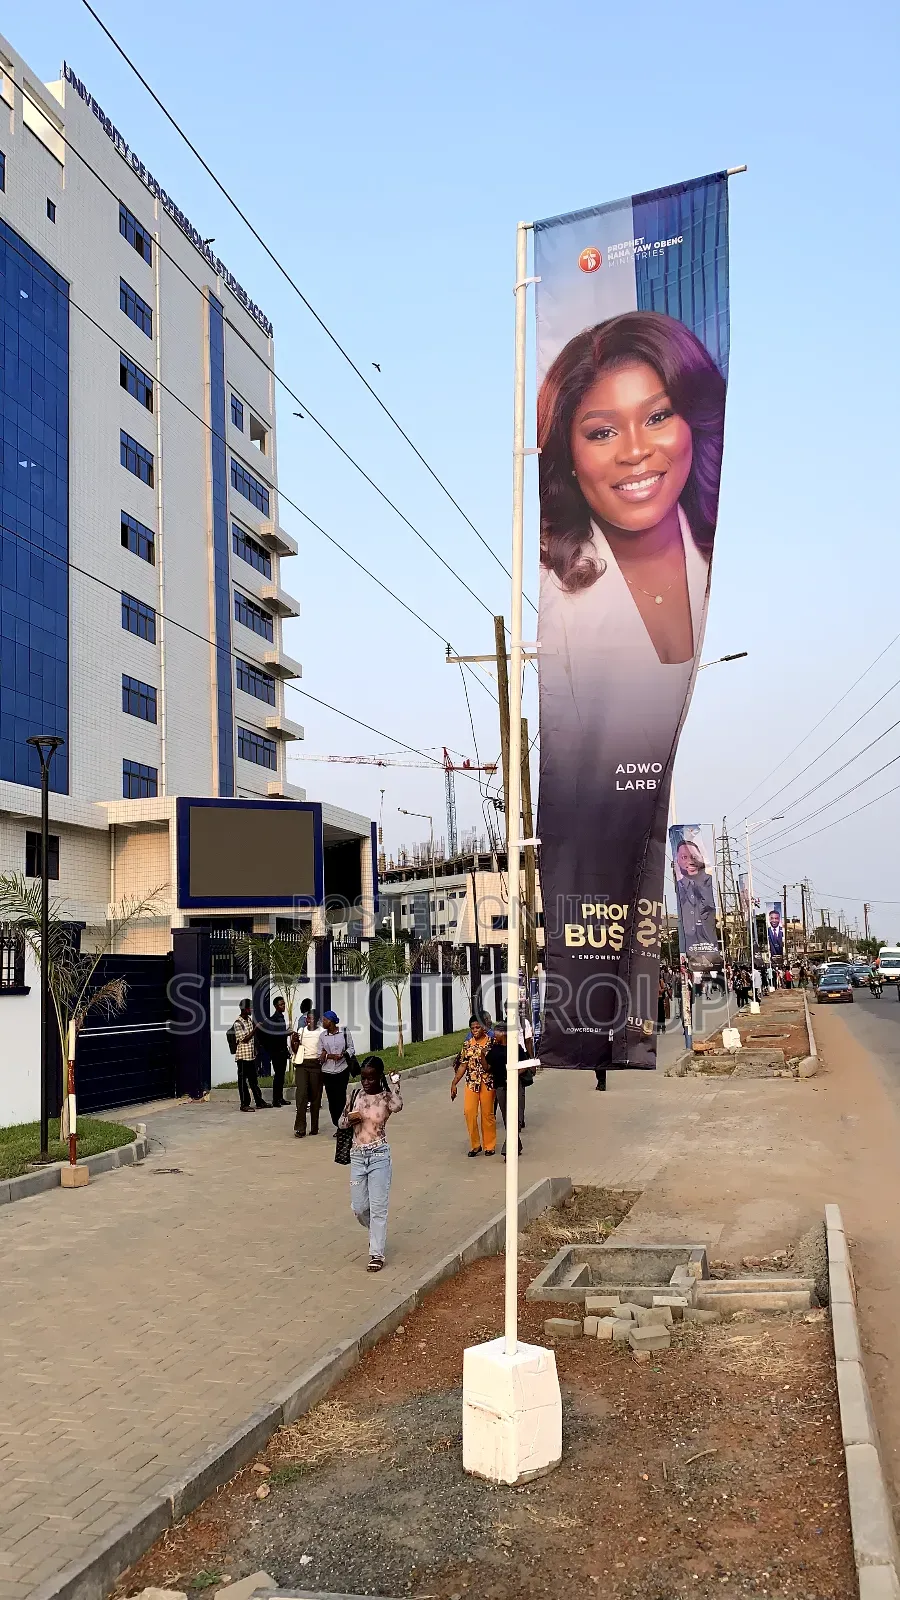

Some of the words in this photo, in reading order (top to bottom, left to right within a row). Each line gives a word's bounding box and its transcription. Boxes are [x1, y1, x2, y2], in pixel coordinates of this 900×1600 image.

[63, 60, 130, 157] UNIVERSITY
[131, 152, 147, 178] OF
[147, 169, 216, 266] PROFESSIONAL
[216, 257, 248, 305] STUDIES
[248, 299, 274, 338] ACCRA
[607, 237, 645, 254] PROPHET
[607, 248, 631, 261] NANA
[632, 243, 652, 254] YAW
[654, 236, 684, 249] OBENG
[608, 248, 665, 268] MINISTRIES
[616, 779, 661, 791] LARB
